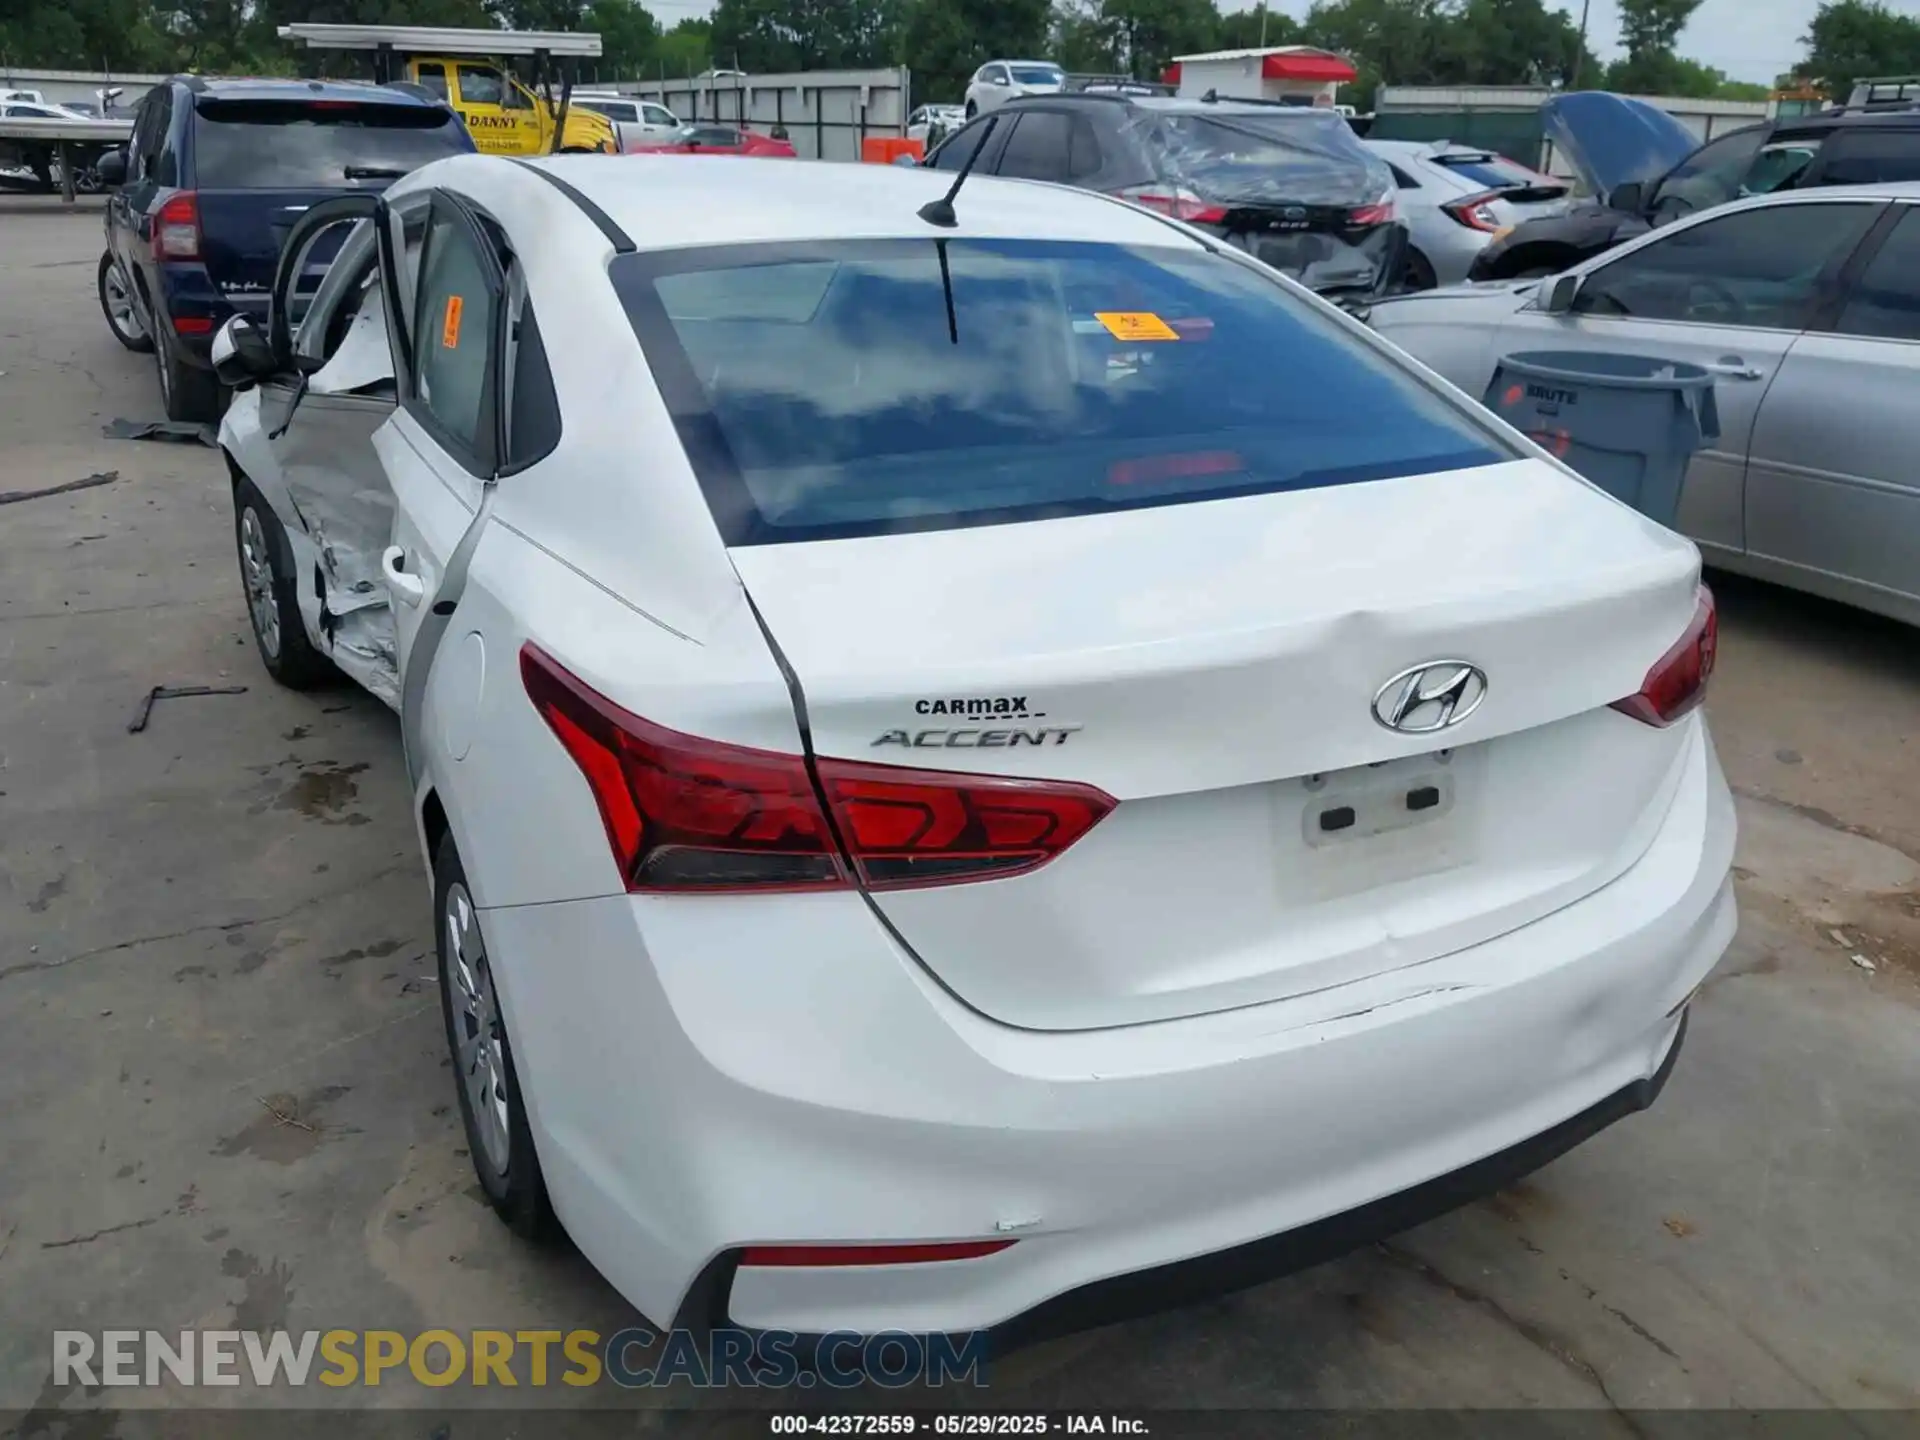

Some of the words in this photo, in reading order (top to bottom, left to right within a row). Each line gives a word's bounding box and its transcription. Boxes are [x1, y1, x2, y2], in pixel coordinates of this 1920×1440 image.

[469, 115, 518, 129] DANNY
[1526, 384, 1578, 405] BRUTE
[870, 723, 1084, 748] ACCENT
